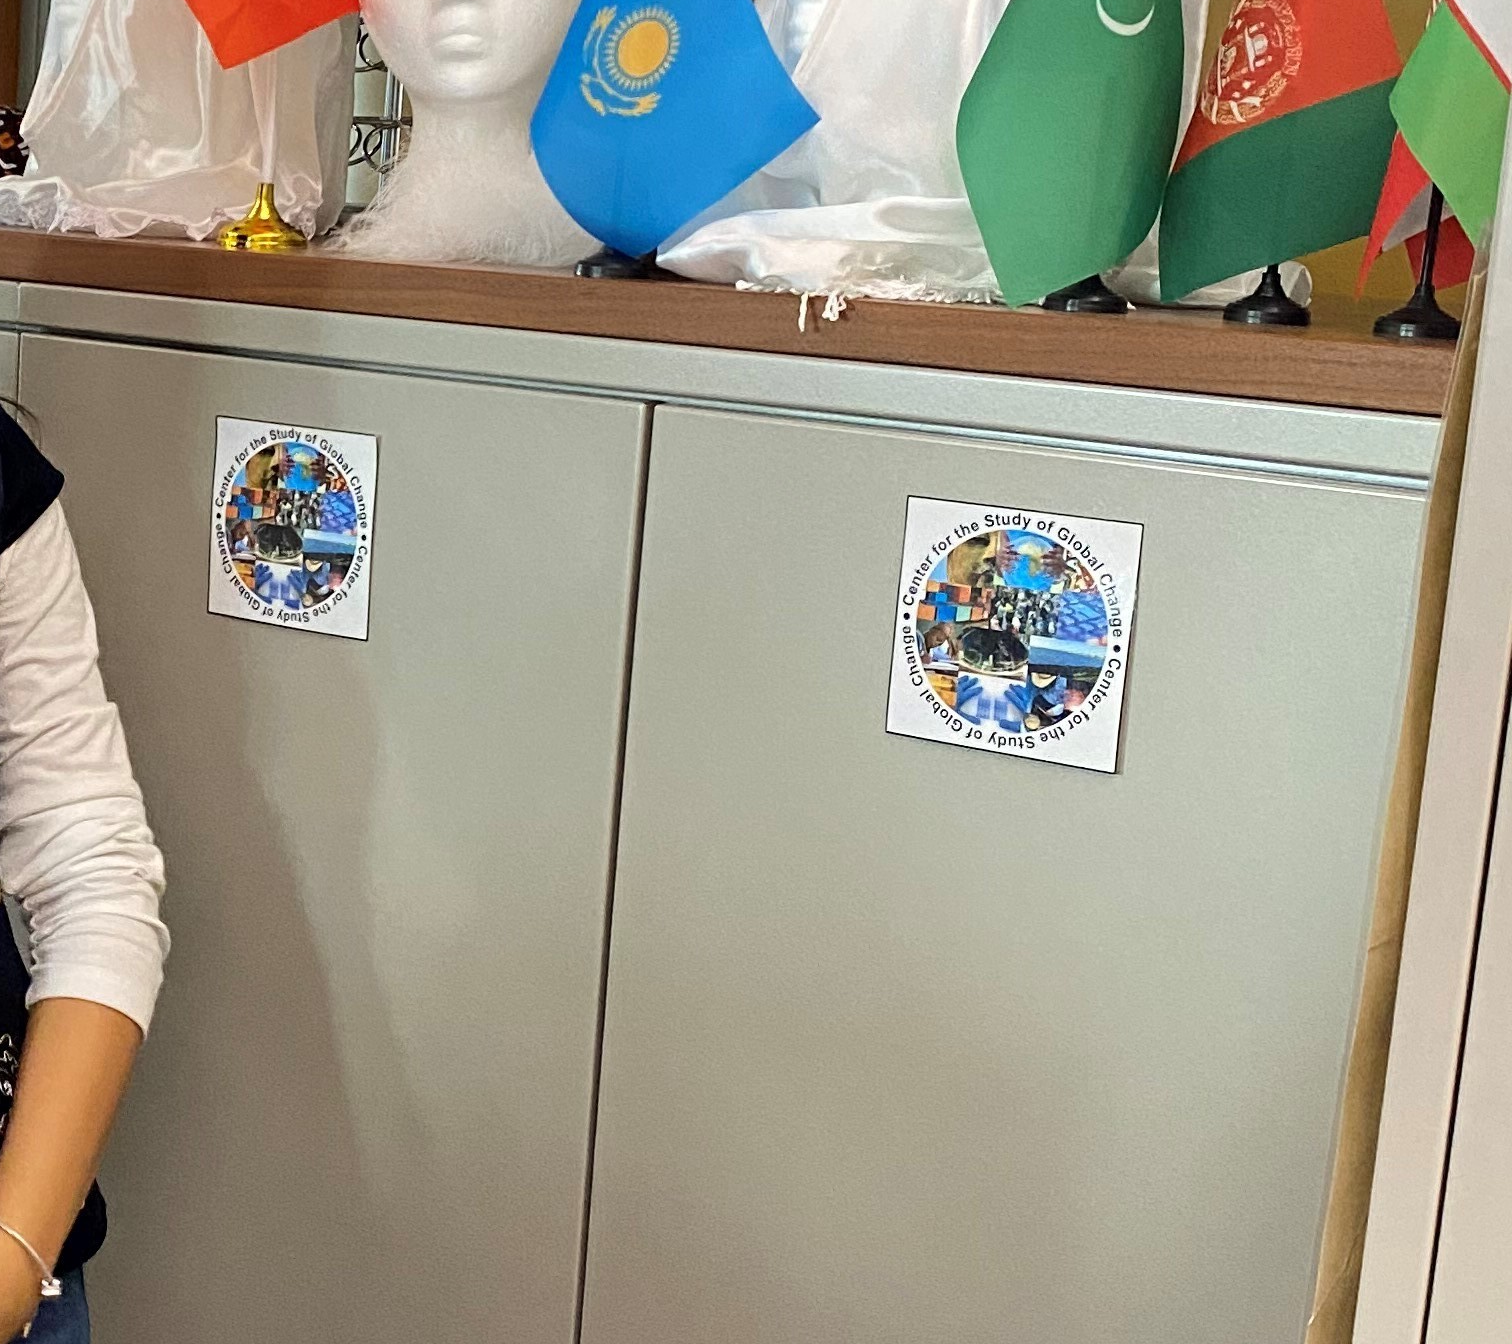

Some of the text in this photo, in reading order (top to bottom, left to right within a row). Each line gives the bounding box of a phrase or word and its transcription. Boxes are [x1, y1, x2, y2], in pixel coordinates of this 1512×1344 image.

[215, 428, 367, 529] Center for the Study of Global Change
[215, 523, 368, 623] Center for the Study of Global Change
[902, 513, 1122, 638] Center for the Study of Global Change
[903, 626, 1121, 748] Center for the Study of Global Change
